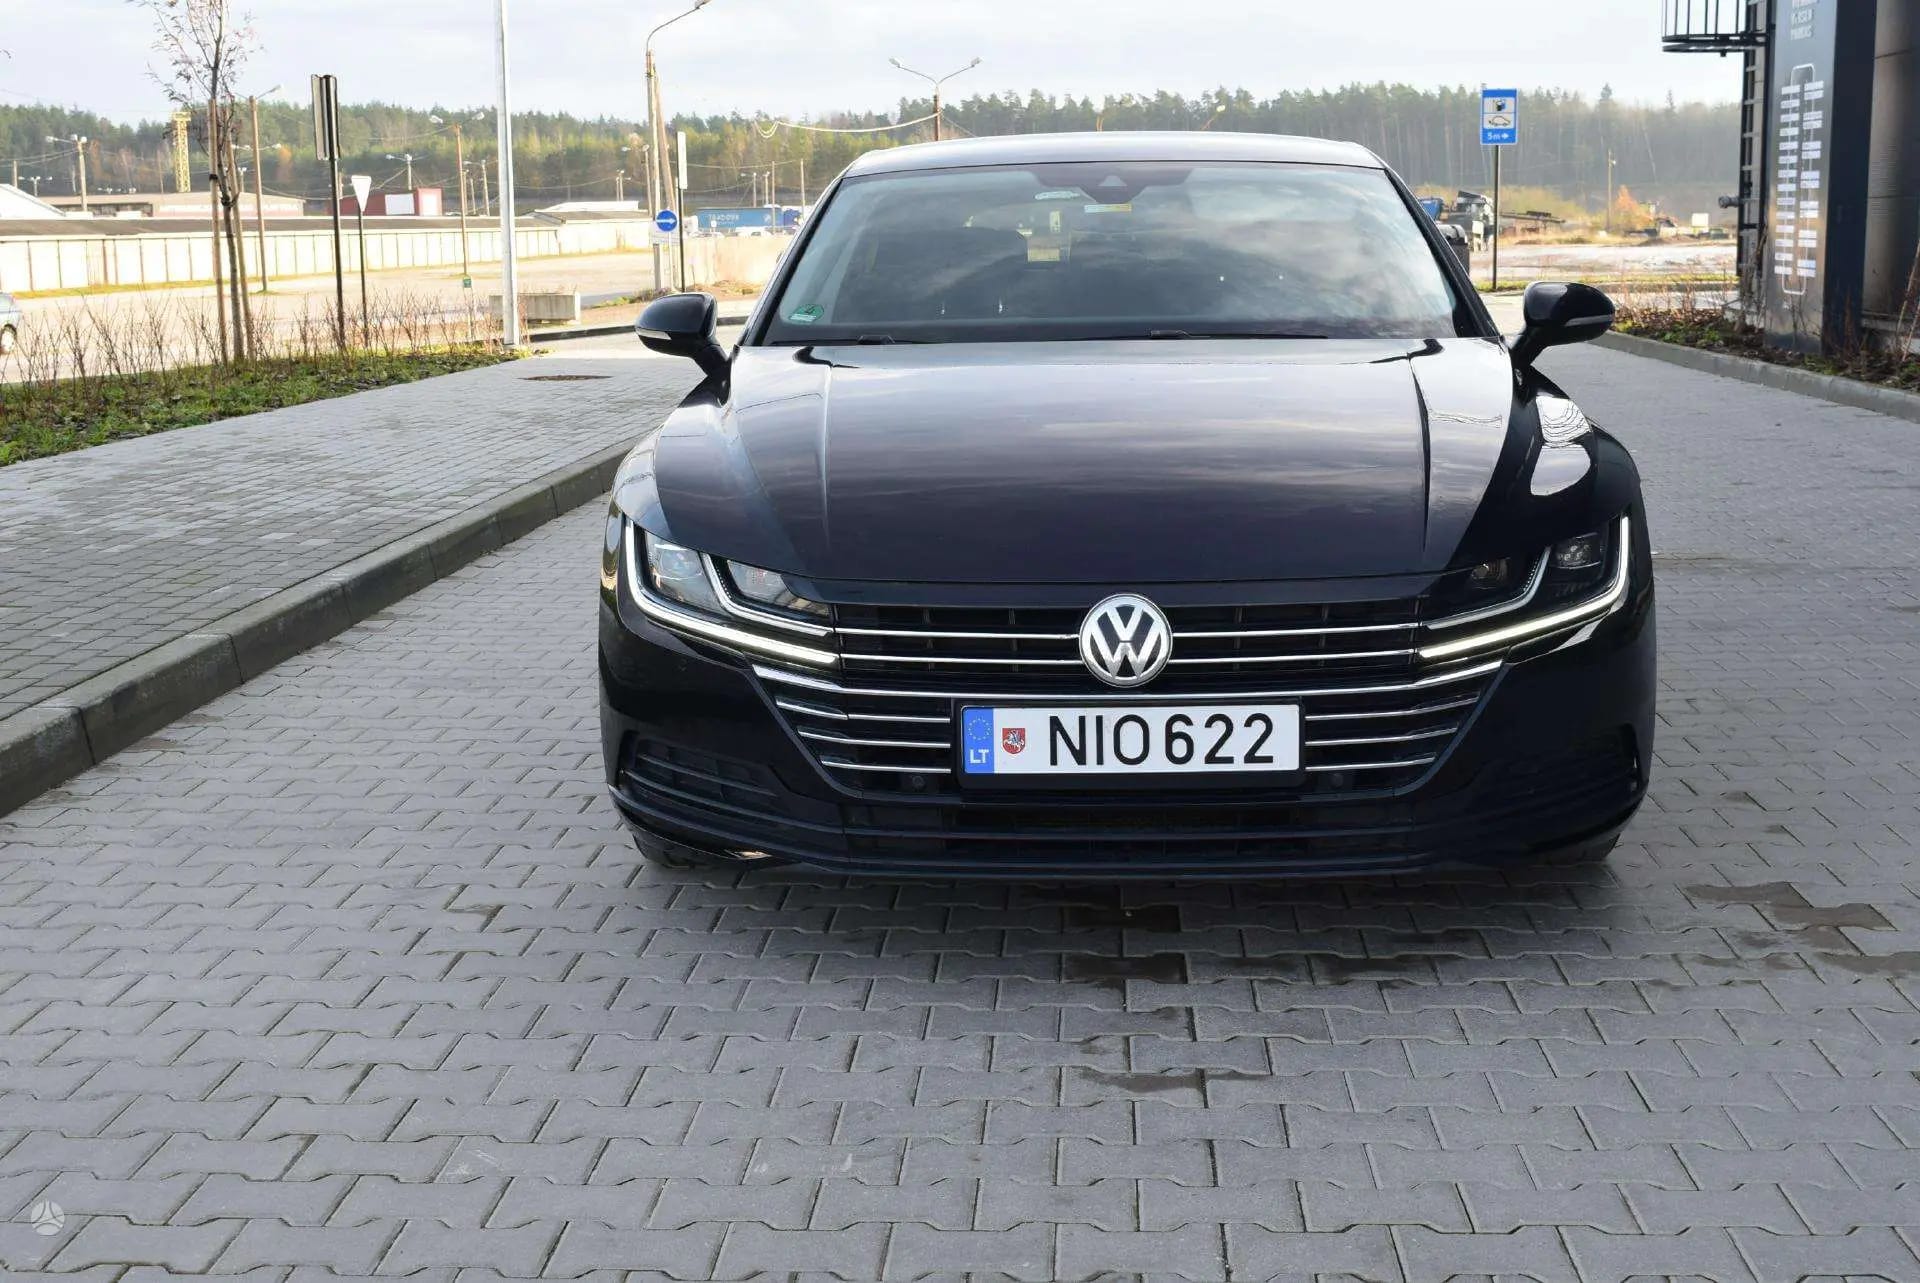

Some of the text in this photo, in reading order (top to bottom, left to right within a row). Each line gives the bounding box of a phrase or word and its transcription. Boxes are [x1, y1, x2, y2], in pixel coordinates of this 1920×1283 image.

[969, 748, 990, 765] LT
[1049, 712, 1274, 766] NIO 622
